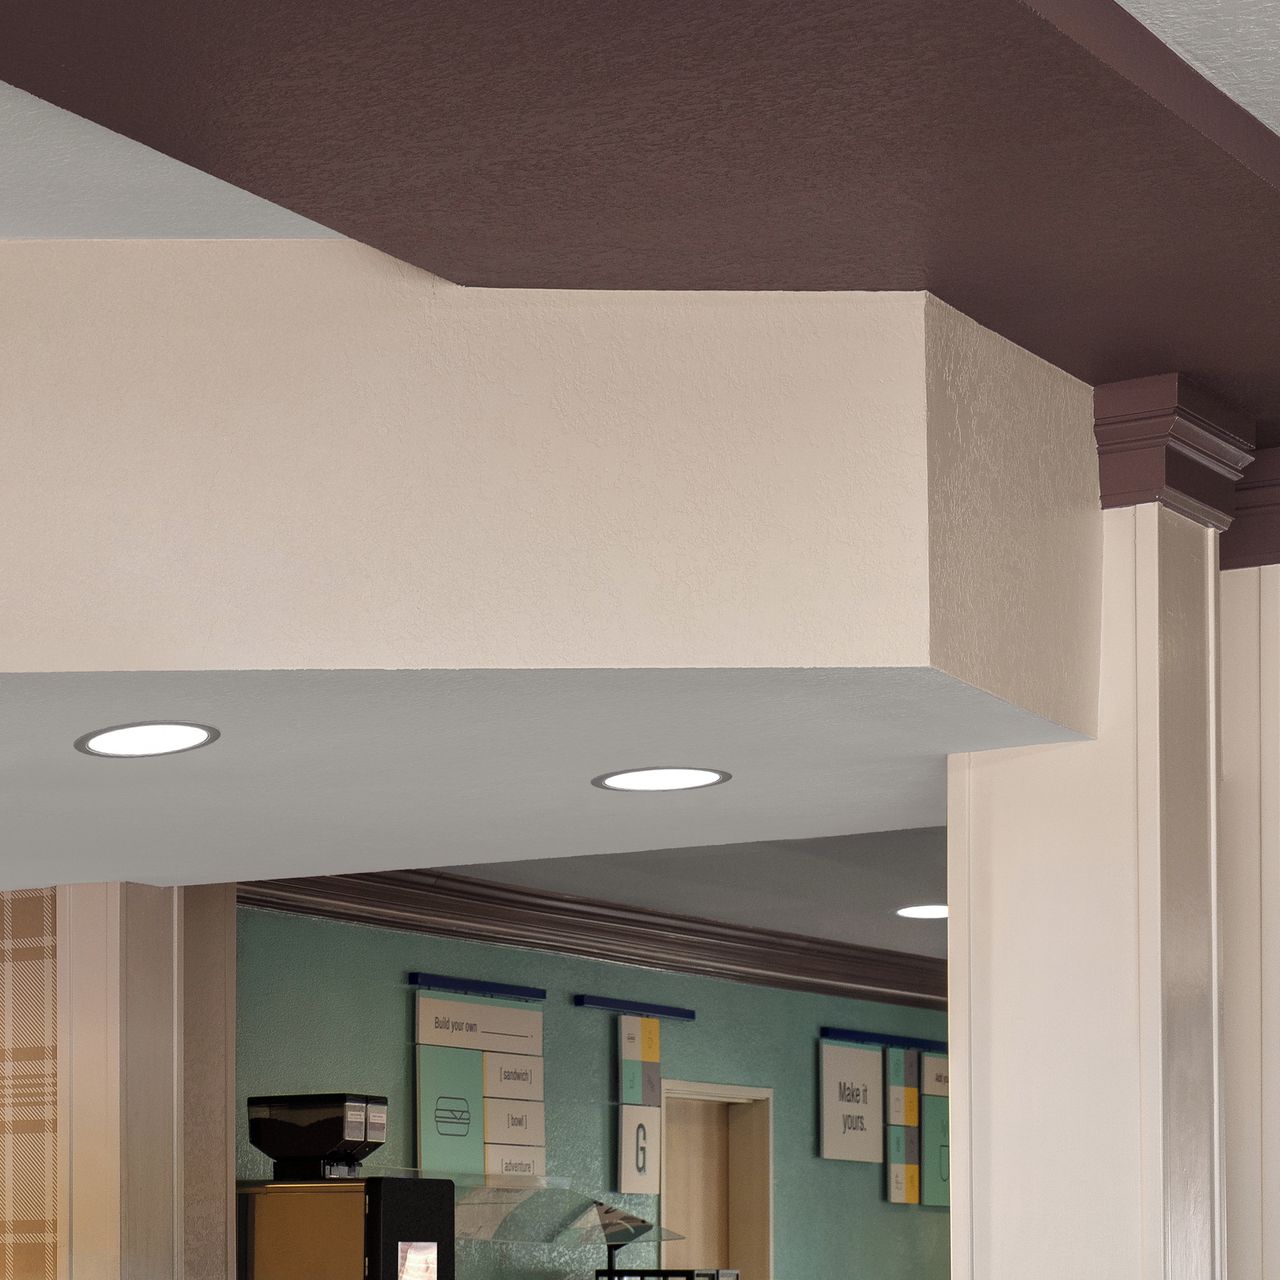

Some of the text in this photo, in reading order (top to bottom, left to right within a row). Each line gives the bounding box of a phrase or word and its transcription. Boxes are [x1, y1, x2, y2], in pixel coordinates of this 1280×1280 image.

[434, 1016, 478, 1033] Build your own
[838, 1081, 868, 1105] Make it
[842, 1113, 867, 1135] yours.
[636, 1122, 647, 1173] G
